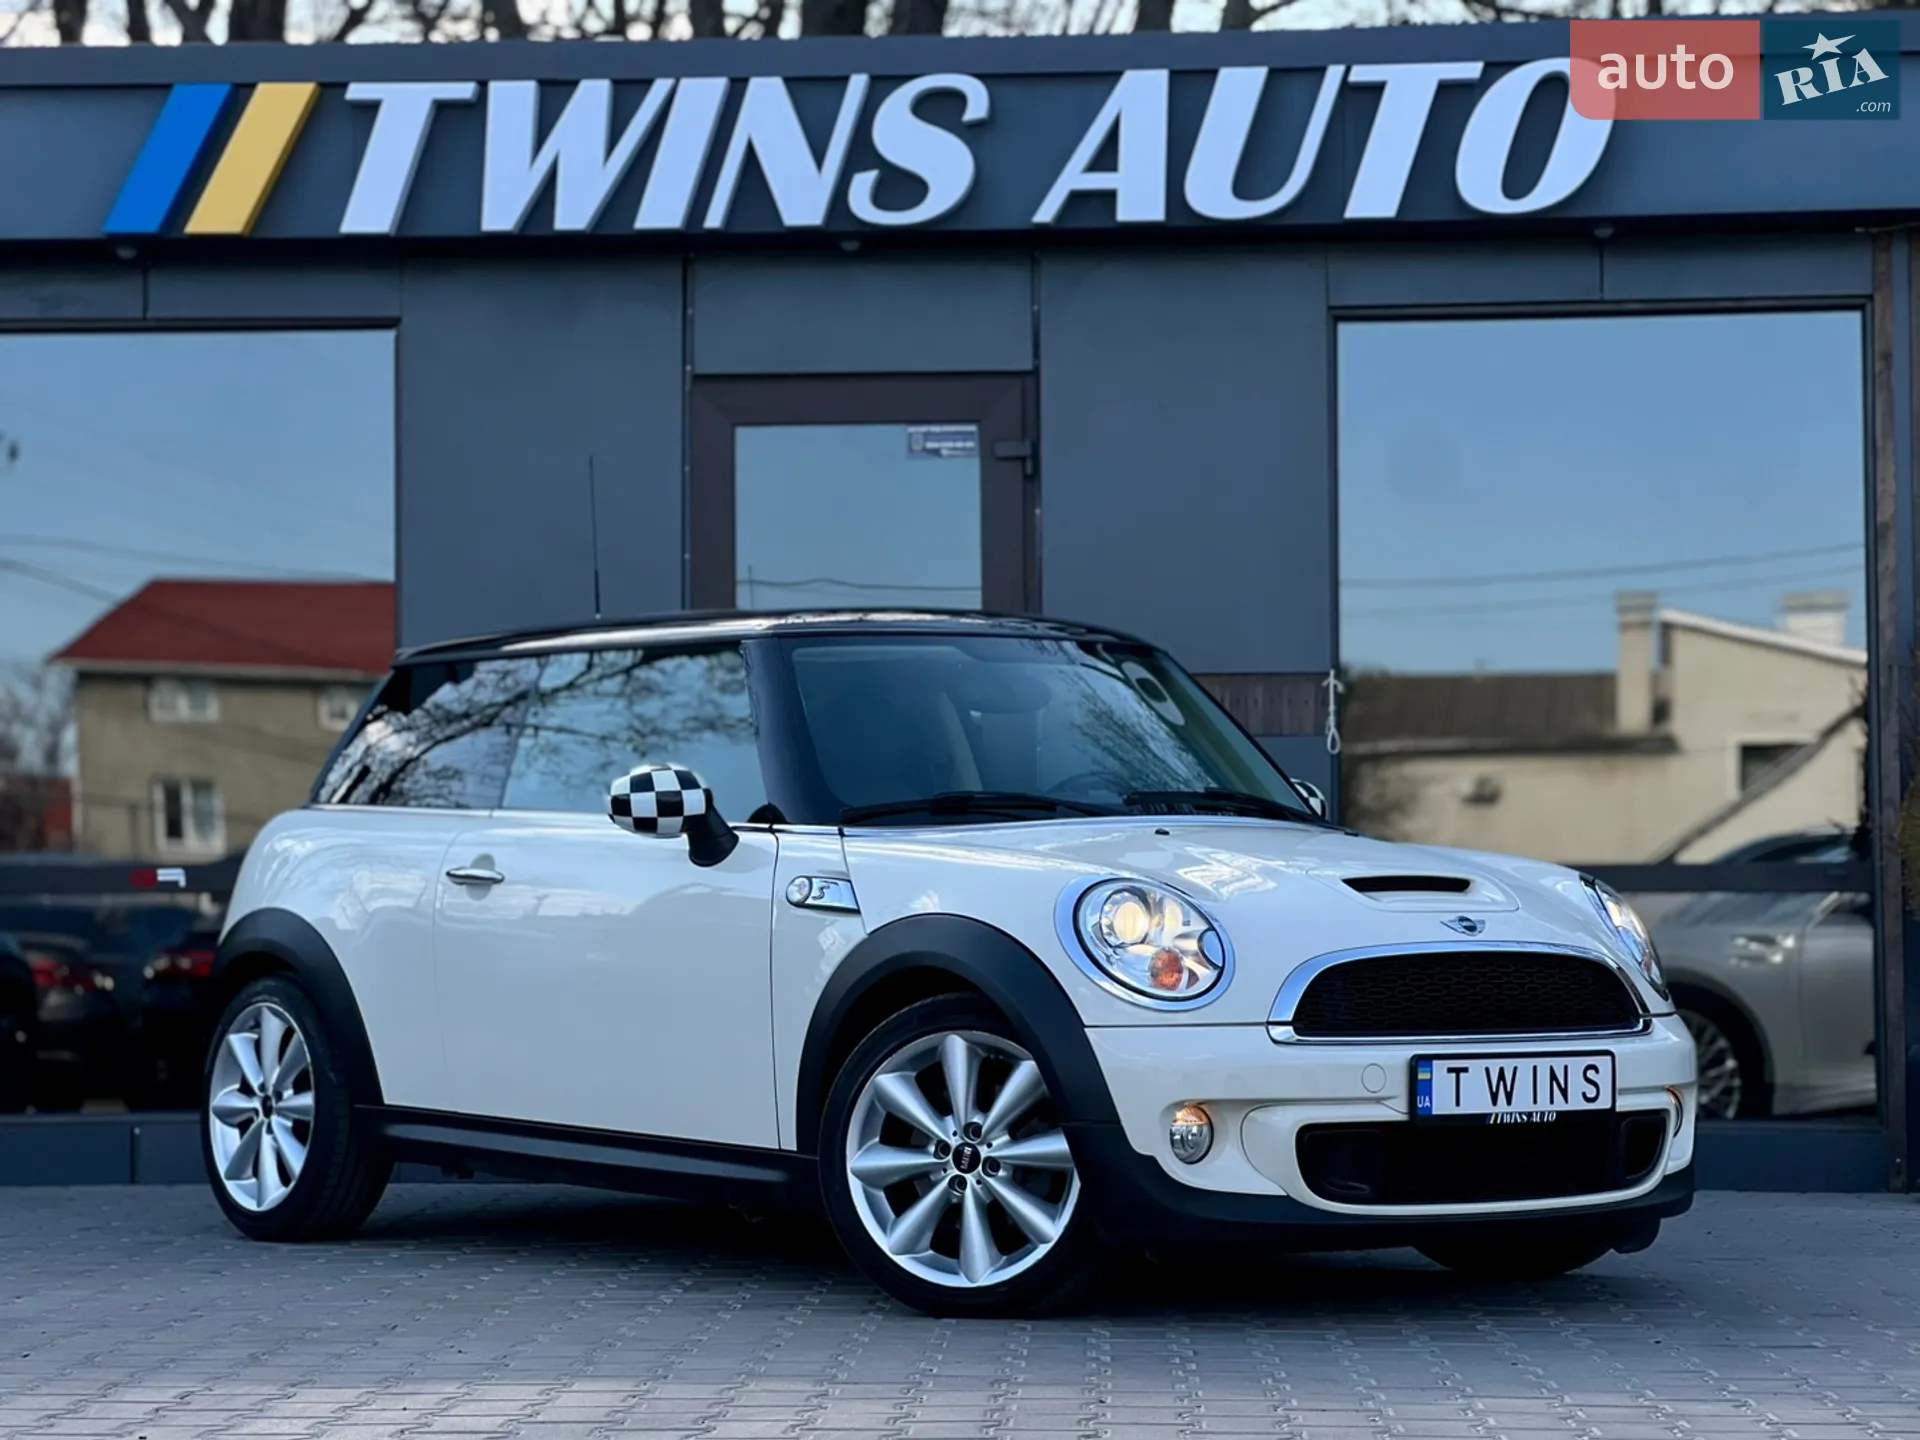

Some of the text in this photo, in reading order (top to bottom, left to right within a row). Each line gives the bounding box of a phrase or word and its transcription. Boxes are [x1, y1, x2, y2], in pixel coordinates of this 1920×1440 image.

[338, 57, 1618, 235] TWINS AUTO
[1416, 1096, 1432, 1109] UA
[1446, 1064, 1601, 1108] TWINS
